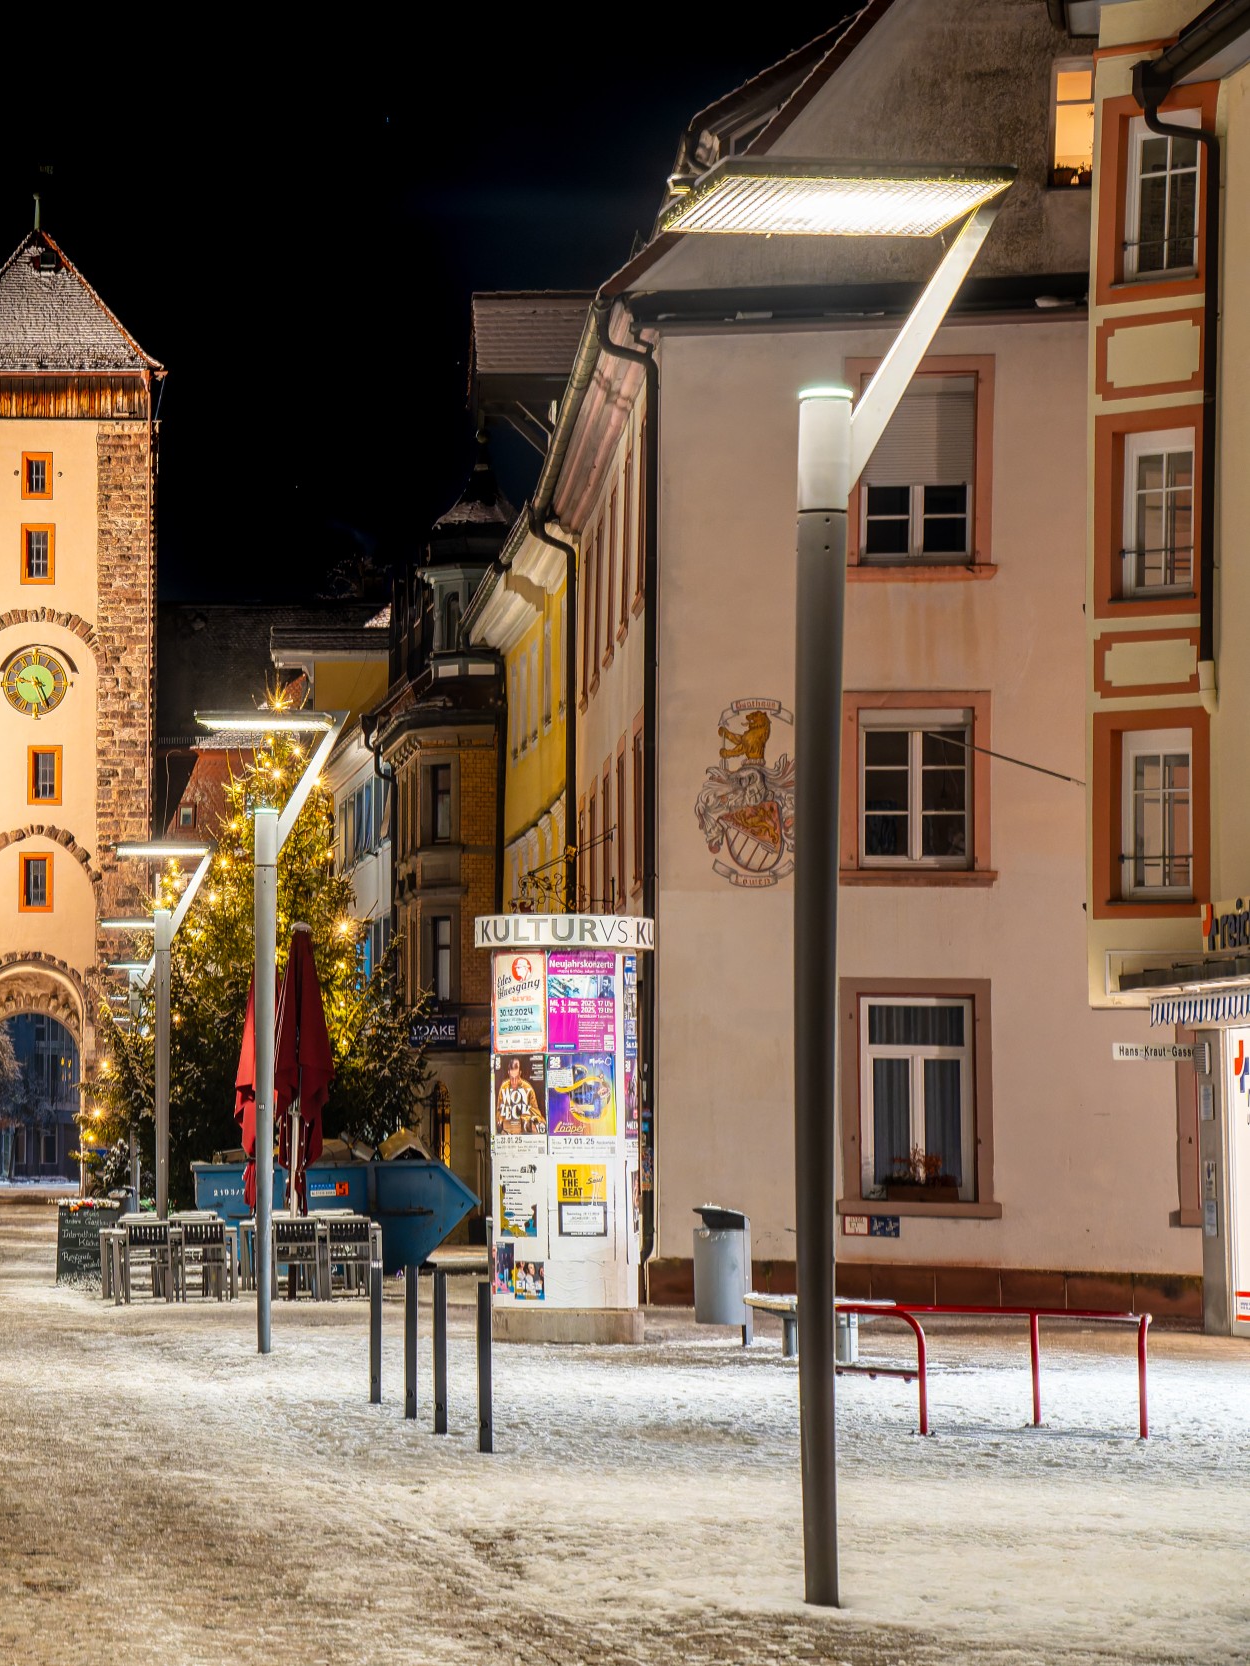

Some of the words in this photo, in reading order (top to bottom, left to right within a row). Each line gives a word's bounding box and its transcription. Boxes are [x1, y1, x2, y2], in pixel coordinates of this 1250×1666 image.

[549, 959, 614, 970] Neujahrskonzerte
[561, 1169, 578, 1178] EAT
[562, 1178, 579, 1188] THE
[562, 1187, 583, 1197] BEAT
